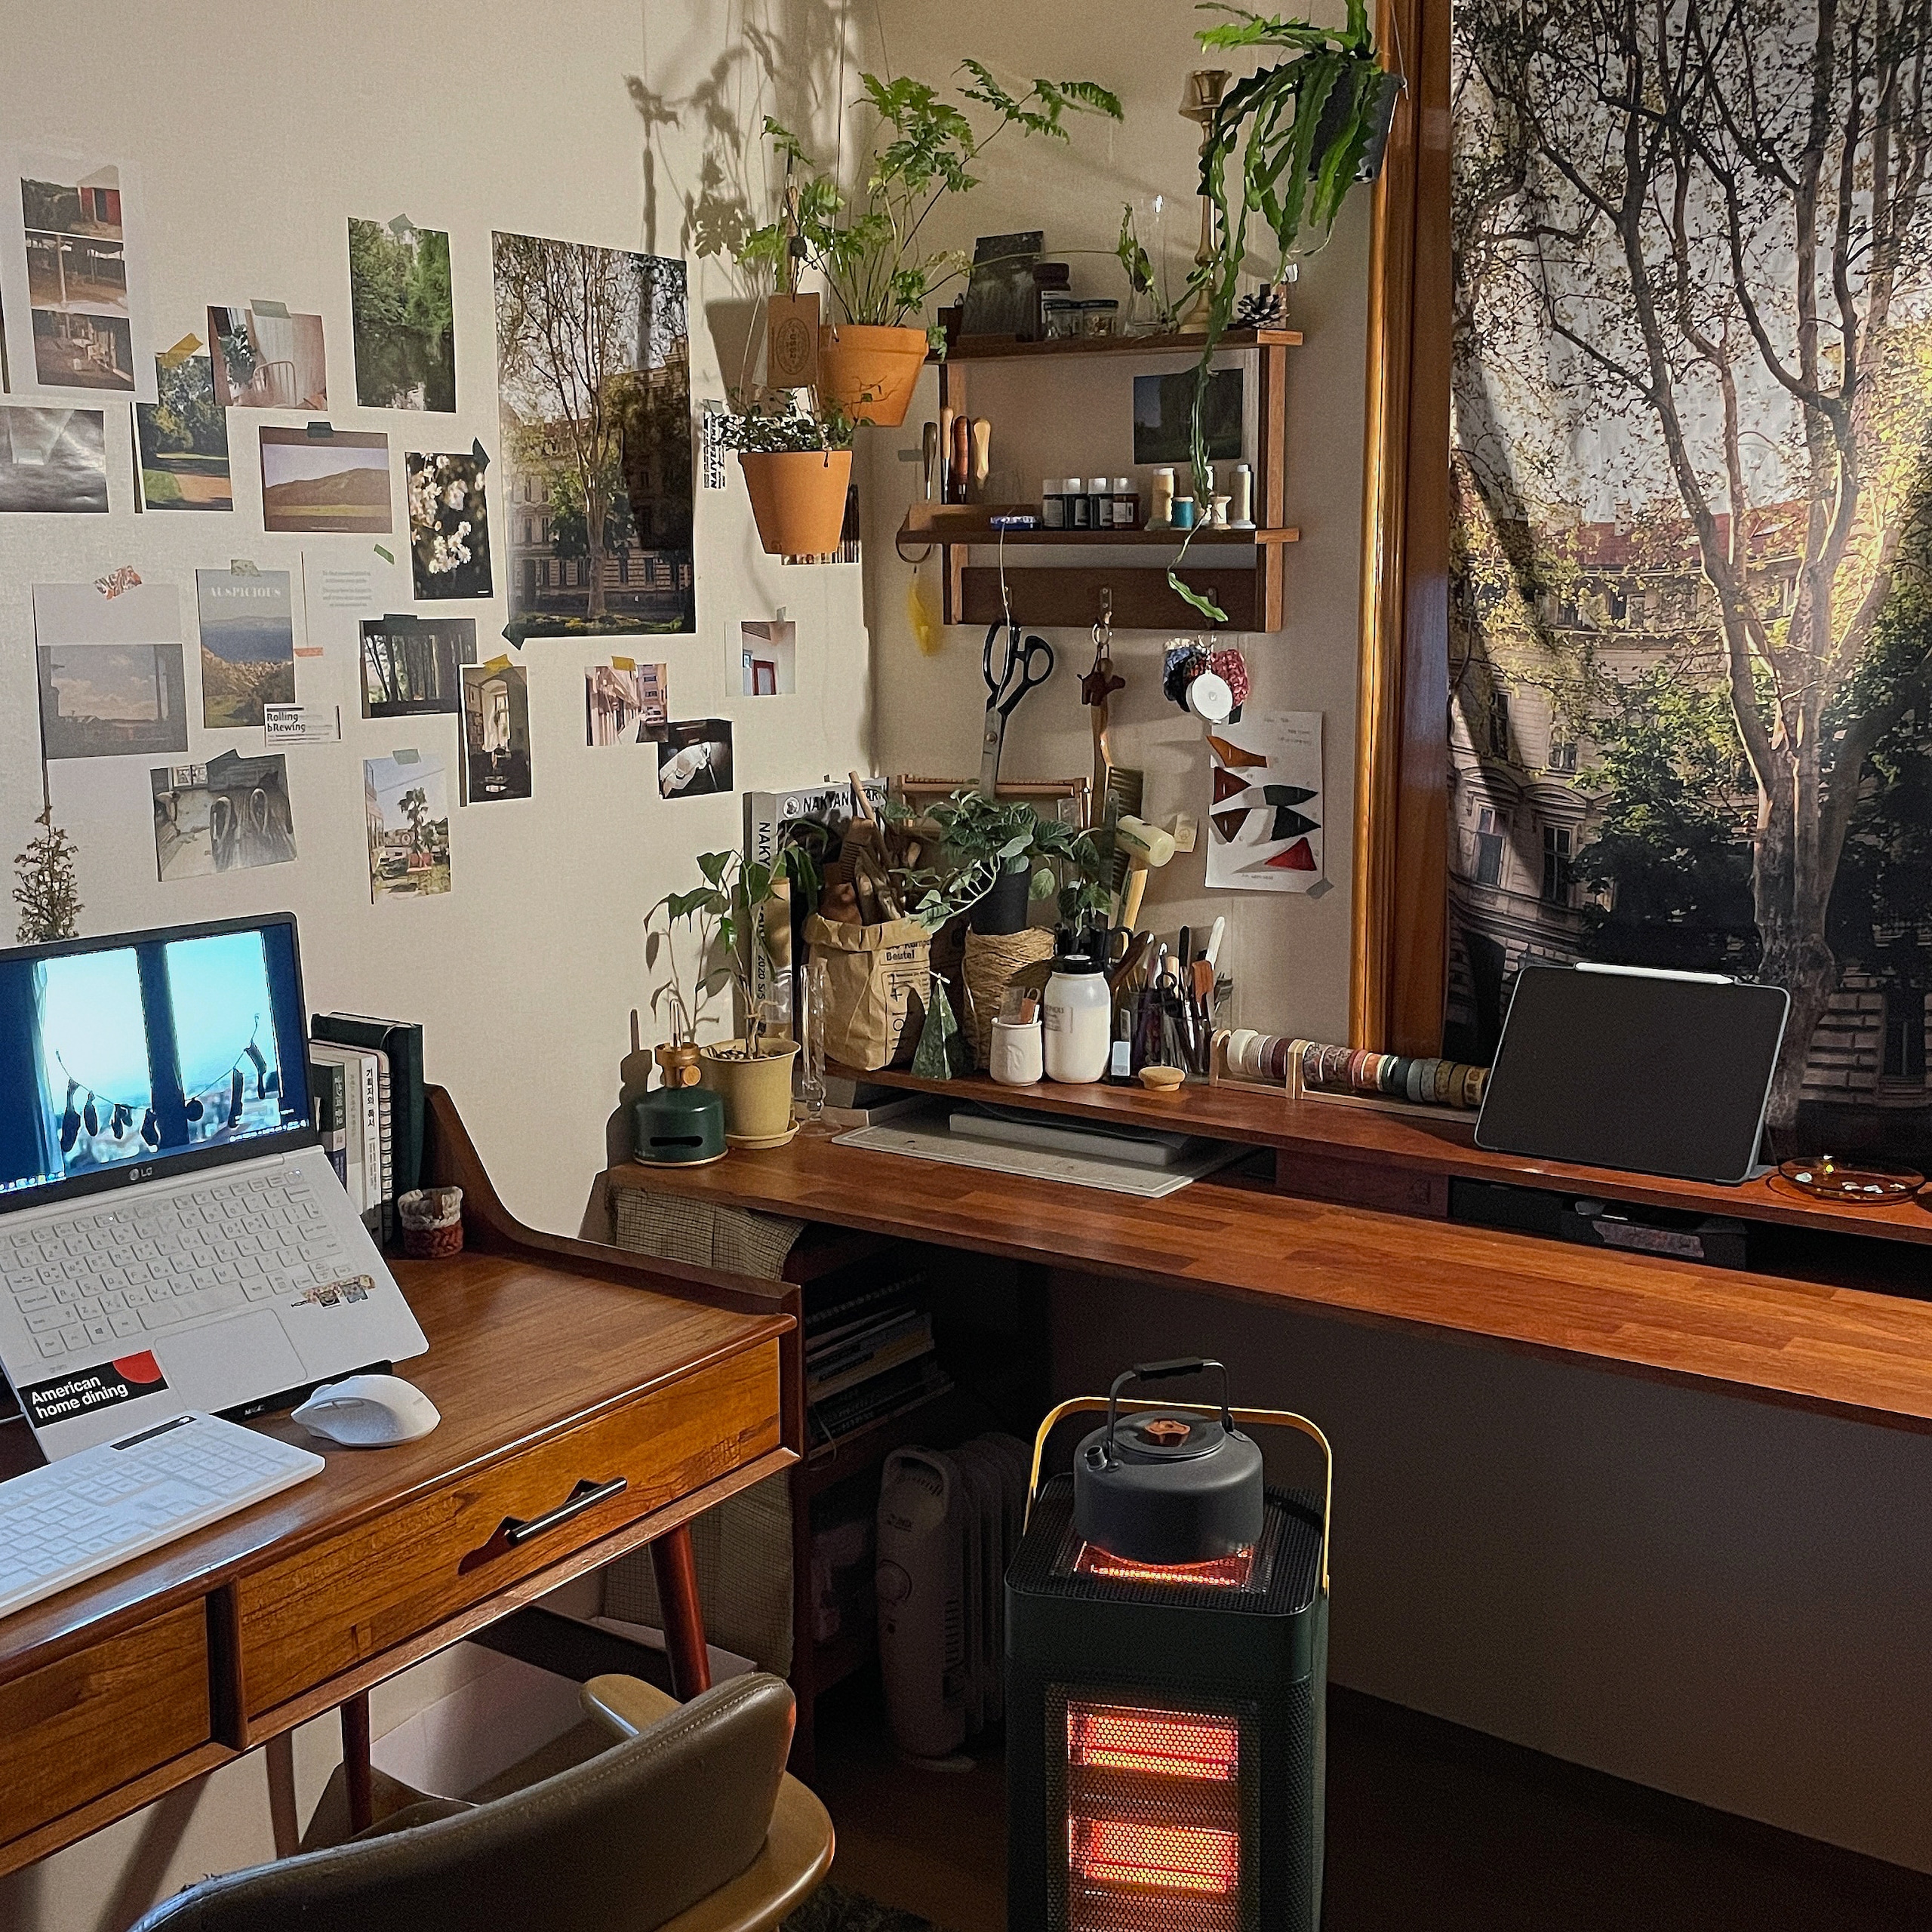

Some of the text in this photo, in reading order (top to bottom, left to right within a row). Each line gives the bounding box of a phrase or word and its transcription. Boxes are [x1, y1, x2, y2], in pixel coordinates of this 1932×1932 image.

[211, 586, 281, 598] AUSPICIOUS
[266, 712, 299, 724] Rolling
[267, 722, 306, 733] bRewing
[803, 790, 849, 813] NAKYAN
[140, 1167, 152, 1177] LG
[32, 1376, 102, 1405] American
[35, 1383, 128, 1420] home dining
